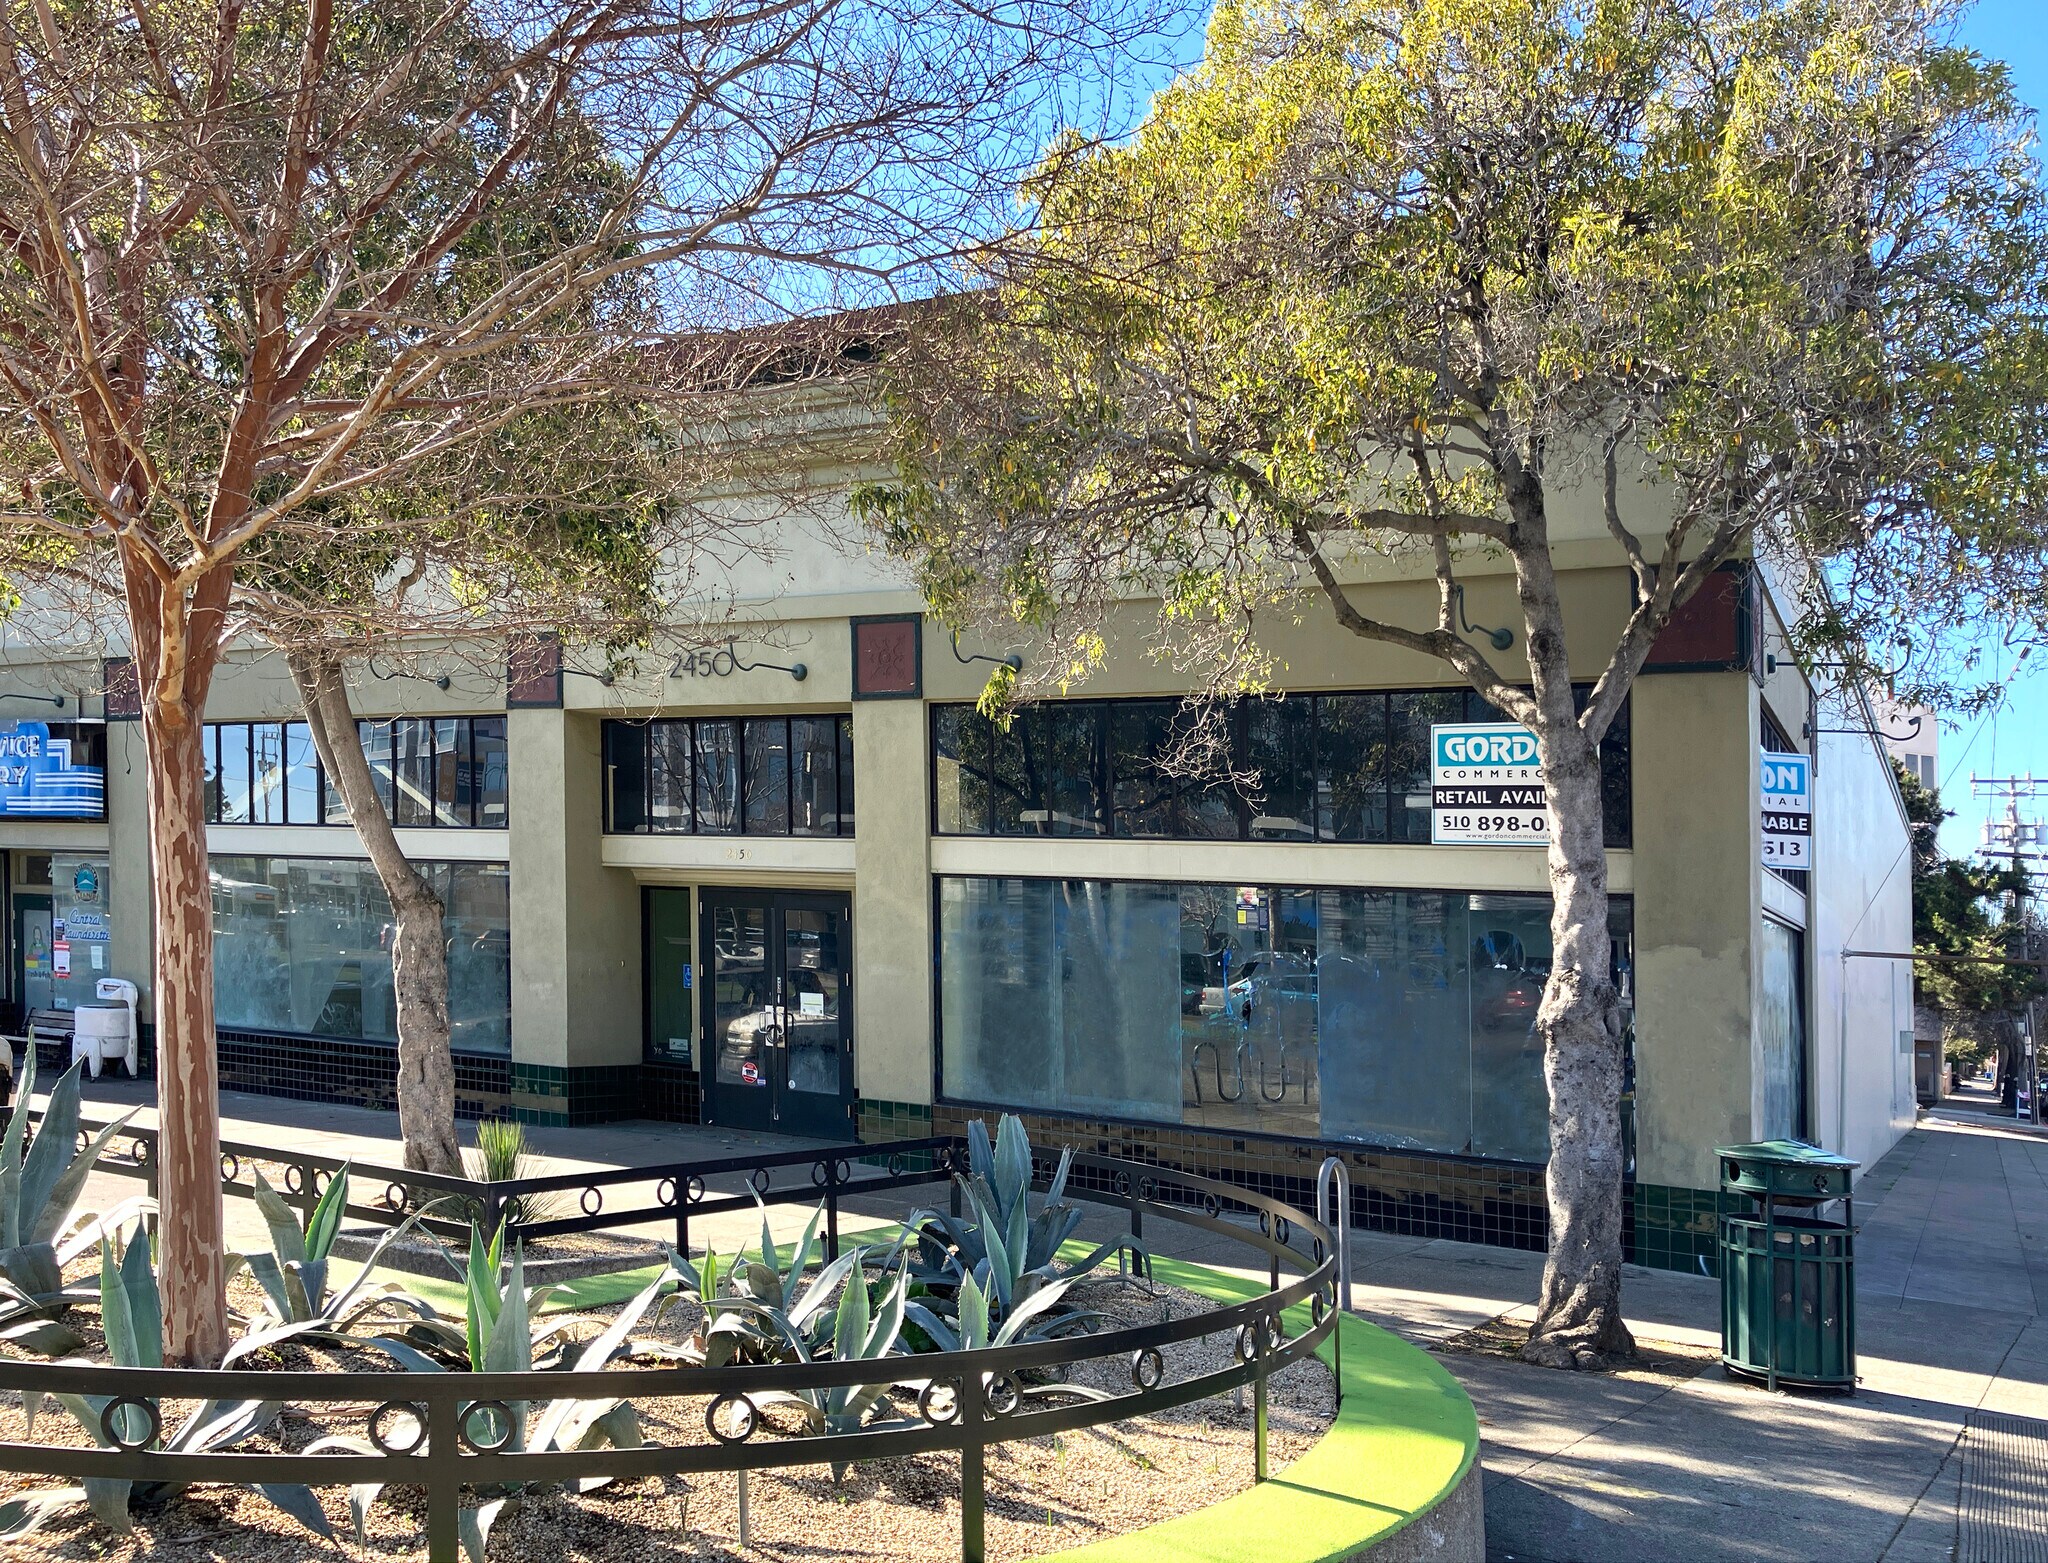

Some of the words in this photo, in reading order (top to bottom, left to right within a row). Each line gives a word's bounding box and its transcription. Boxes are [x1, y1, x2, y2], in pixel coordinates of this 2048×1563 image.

[669, 650, 733, 678] 2450
[1435, 790, 1492, 804] RETAIL
[1443, 815, 1471, 828] 510
[1477, 816, 1550, 832] 898-0
[69, 907, 103, 926] Central
